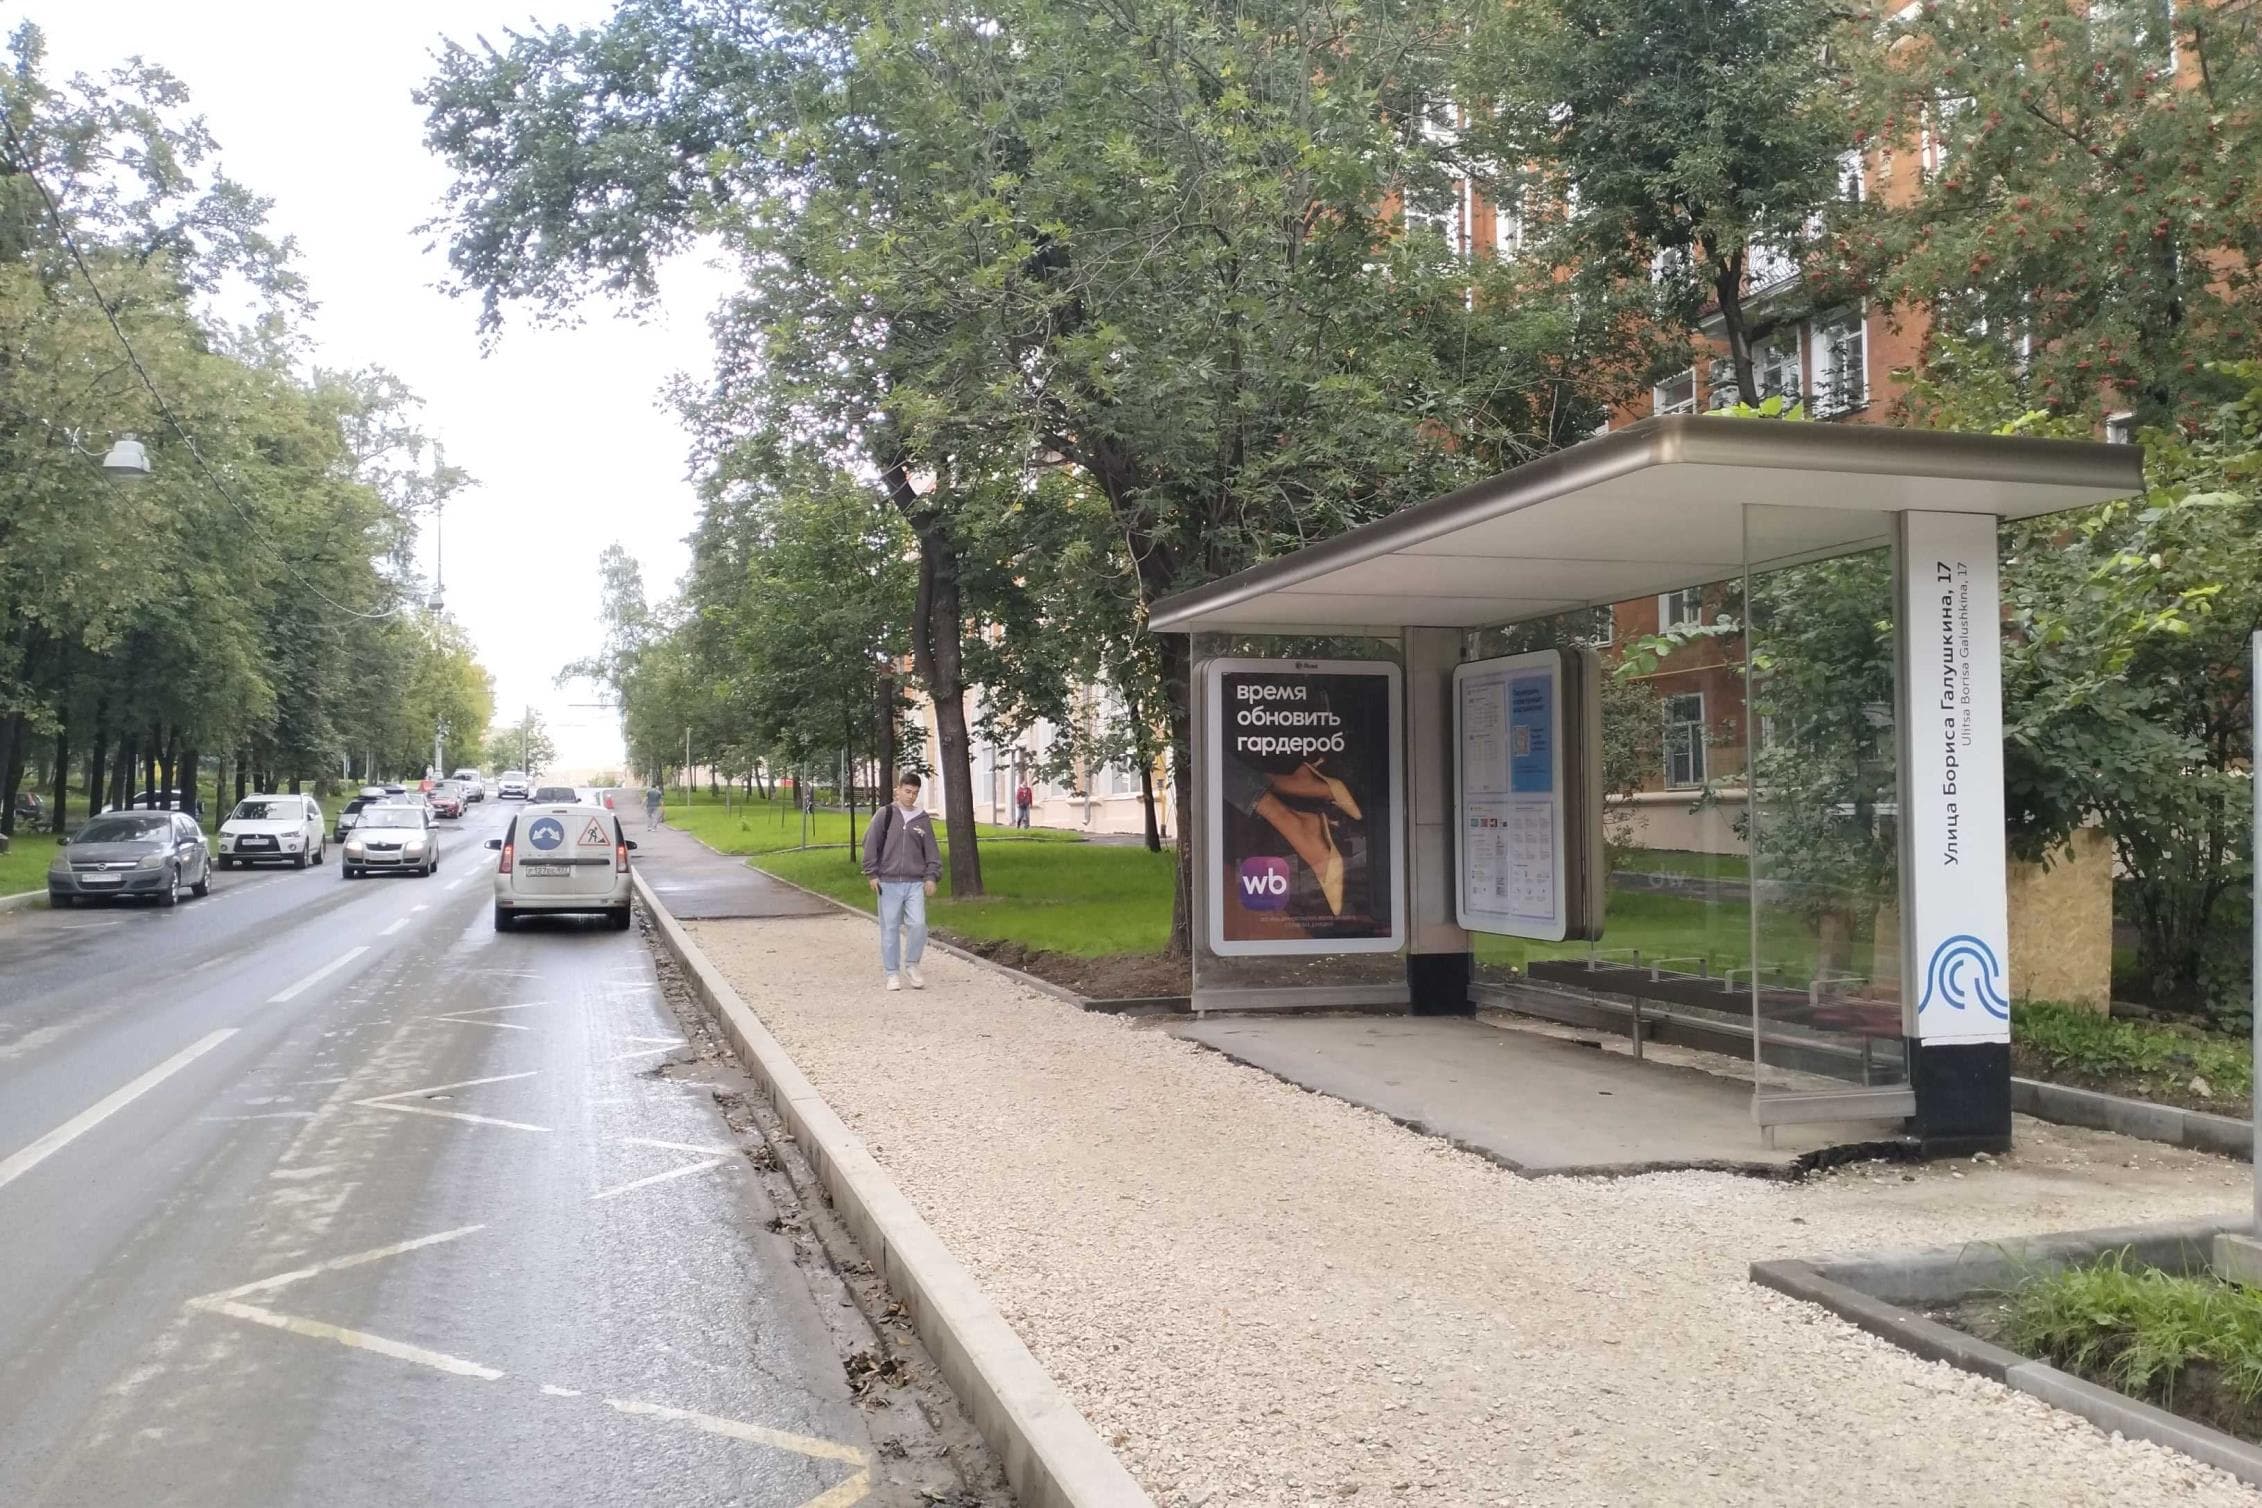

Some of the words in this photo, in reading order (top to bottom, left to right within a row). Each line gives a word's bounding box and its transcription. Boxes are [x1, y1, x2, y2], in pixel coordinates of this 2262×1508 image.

[1937, 561, 1951, 583] 17
[1957, 562, 1967, 576] 17
[1958, 580, 1969, 658] Galushkina,
[1941, 590, 1957, 710] Галушкина,
[1236, 684, 1306, 704] время
[1960, 662, 1970, 704] Borisa
[1237, 705, 1341, 726] обновить
[1961, 709, 1971, 746] Ulitsa
[1237, 732, 1345, 756] гардероб
[1943, 717, 1959, 795] Бориса
[1944, 803, 1959, 865] Улица
[1243, 867, 1287, 895] wb
